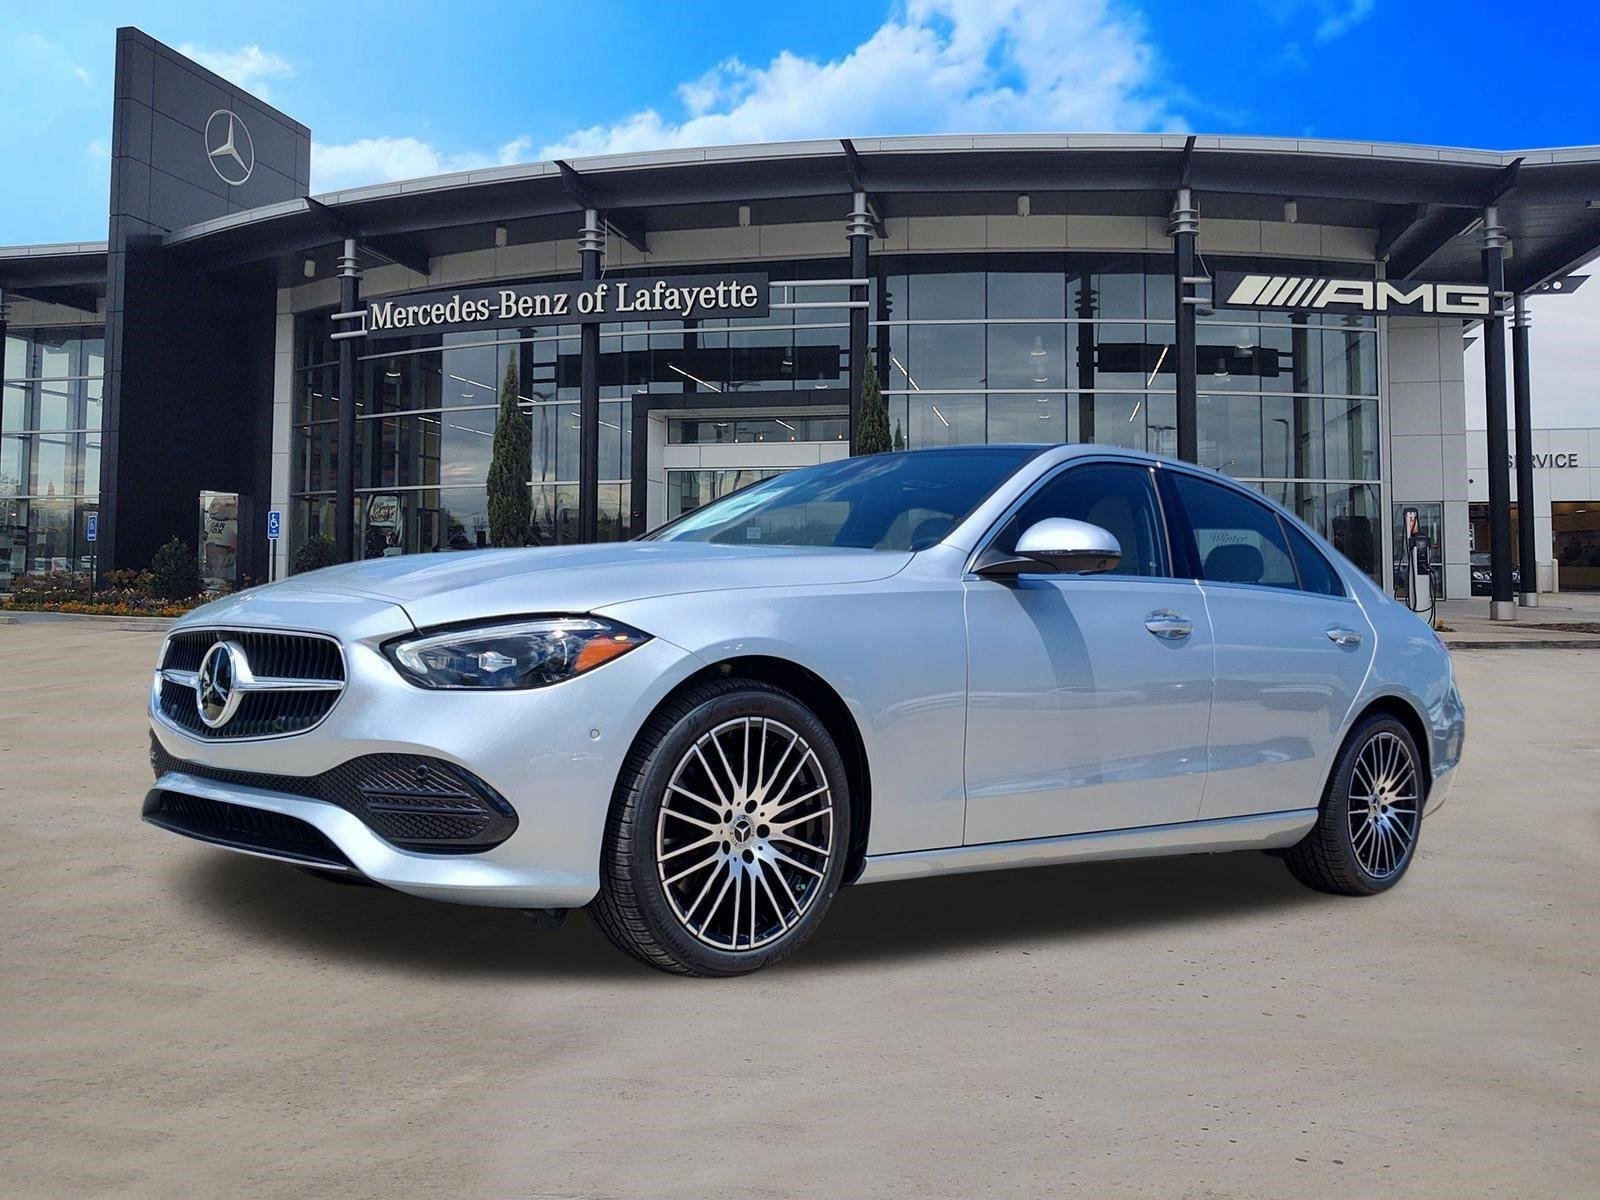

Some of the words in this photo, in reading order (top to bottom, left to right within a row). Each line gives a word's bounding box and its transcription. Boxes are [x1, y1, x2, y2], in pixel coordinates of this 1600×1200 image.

[370, 290, 568, 331] Mercedes-Benz
[577, 283, 608, 314] of
[616, 280, 758, 317] Lafayette
[1312, 279, 1490, 315] AMG
[1210, 530, 1248, 544] Winter
